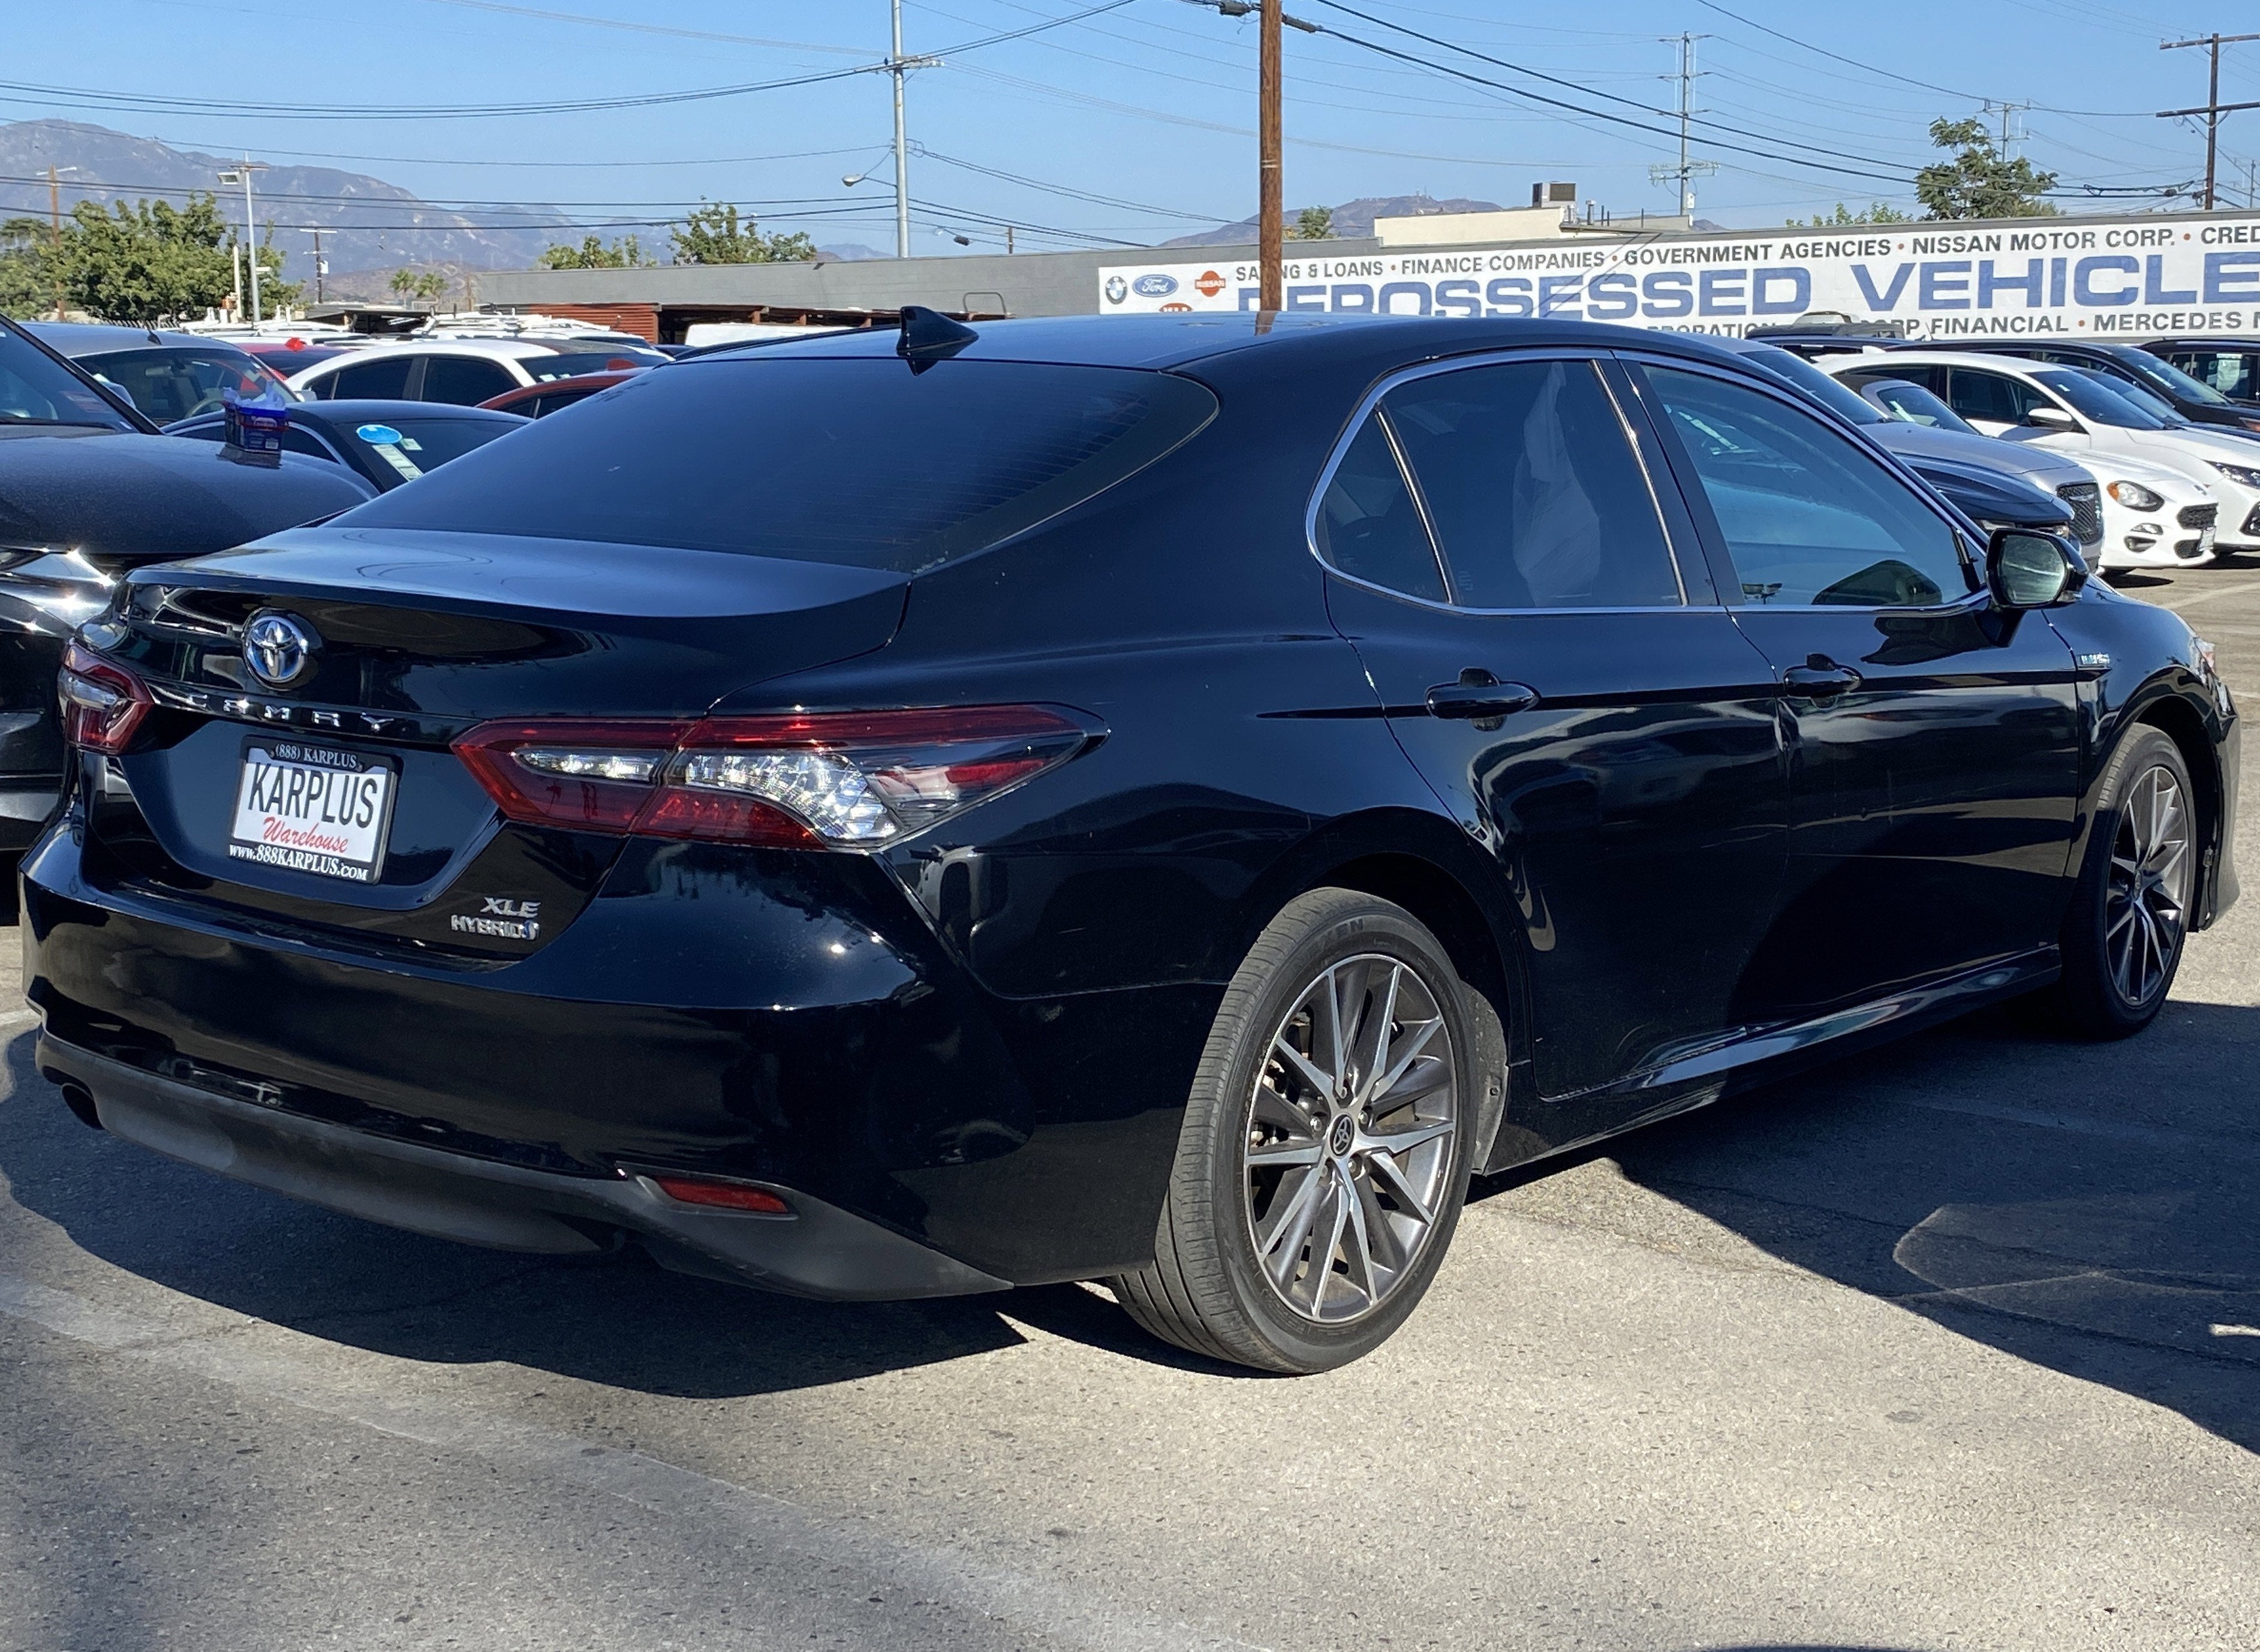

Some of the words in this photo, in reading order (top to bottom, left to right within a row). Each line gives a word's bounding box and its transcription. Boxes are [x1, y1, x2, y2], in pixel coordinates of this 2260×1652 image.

[1236, 264, 1300, 281] SANG
[1308, 263, 1317, 278] &
[1324, 261, 1383, 277] LOANS
[1402, 257, 1482, 274] FINANCE
[1489, 252, 1604, 270] COMPANIES
[1624, 245, 1773, 265] GOVERNMENT
[1780, 240, 1891, 259] AGENCIES
[1912, 234, 2001, 254] NISSAN
[2010, 232, 2096, 251] MOTOR
[2105, 230, 2175, 247] CORP.
[1142, 278, 1169, 293] Ford
[1850, 251, 2260, 311] VEHICLE
[1930, 315, 2069, 334] FINANCIAL
[2093, 312, 2242, 331] MERCEDES
[186, 694, 394, 731] CAMRY
[275, 744, 300, 759] (888)
[303, 748, 356, 770] KARPLUS
[248, 762, 378, 828] KARPLUS
[263, 817, 348, 853] Warehouse
[480, 897, 541, 918] XLE
[451, 914, 521, 939] HYBRID
